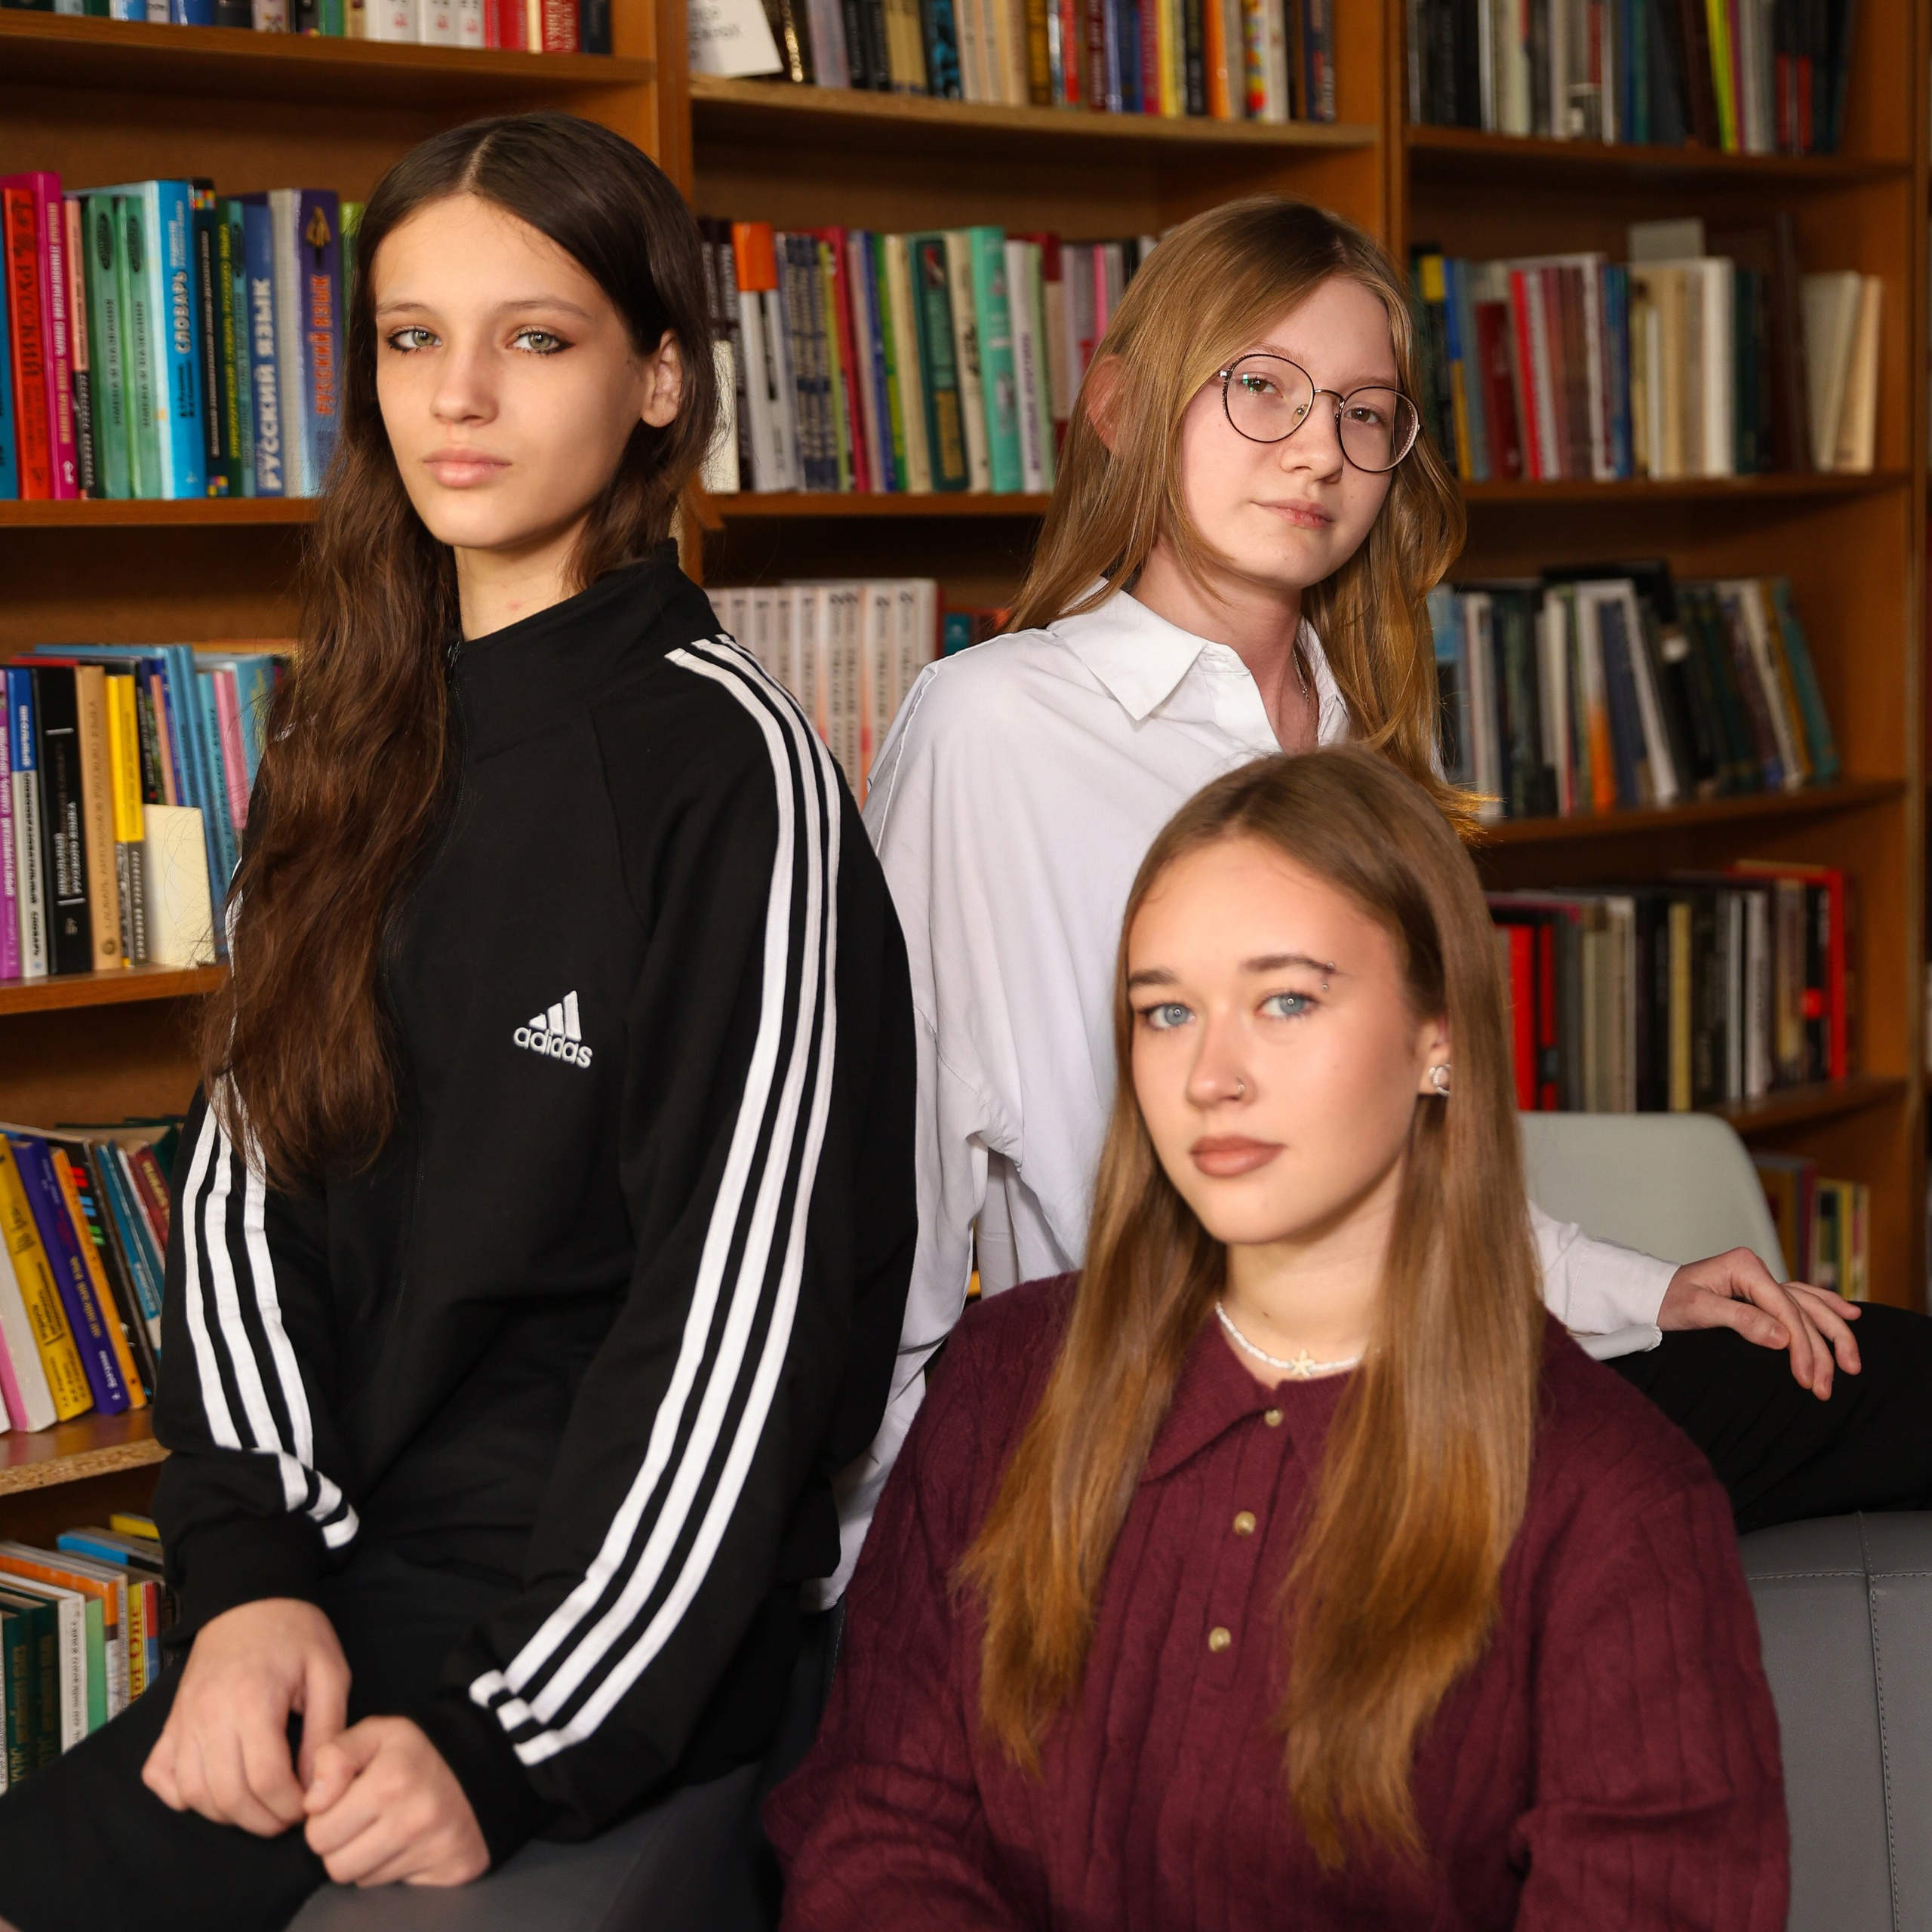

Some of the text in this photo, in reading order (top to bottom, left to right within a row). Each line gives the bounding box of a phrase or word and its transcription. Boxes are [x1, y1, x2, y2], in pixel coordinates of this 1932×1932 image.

[172, 271, 190, 353] СЛОВАРЬ
[252, 278, 274, 357] ЯЗЫК
[309, 274, 333, 329] ЯЗЫК
[309, 331, 334, 415] РУССКИЙ
[254, 364, 282, 489] РУССКИЙ
[513, 1026, 593, 1069] adidas
